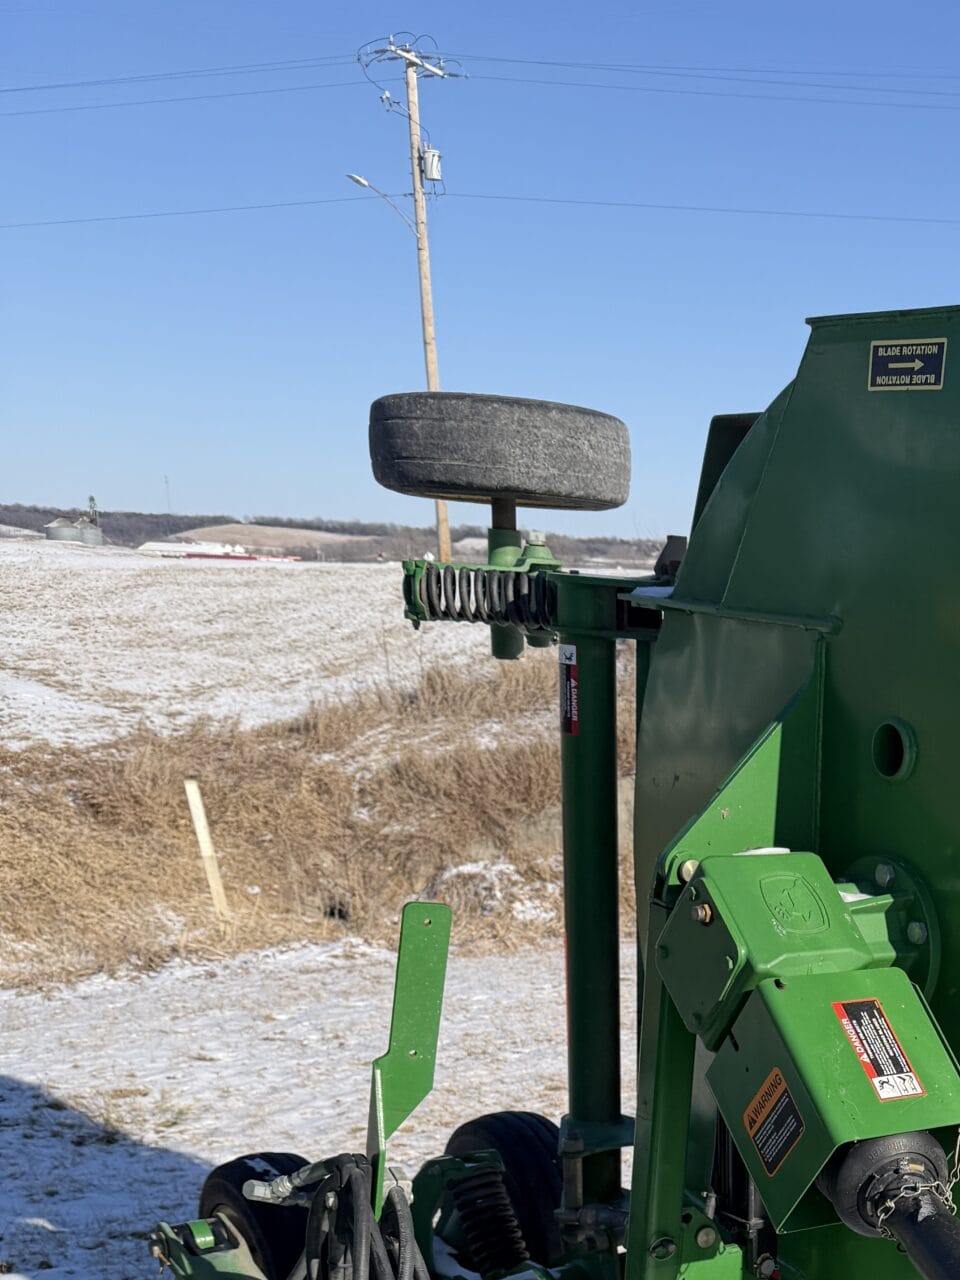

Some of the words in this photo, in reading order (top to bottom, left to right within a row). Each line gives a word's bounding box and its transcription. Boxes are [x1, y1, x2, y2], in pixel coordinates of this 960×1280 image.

[878, 347, 901, 356] BLADE
[902, 345, 938, 355] ROTATION
[876, 375, 911, 384] ROTATION
[912, 374, 936, 383] BLADE
[842, 1018, 865, 1053] DANGER
[752, 1073, 782, 1119] WARNING
